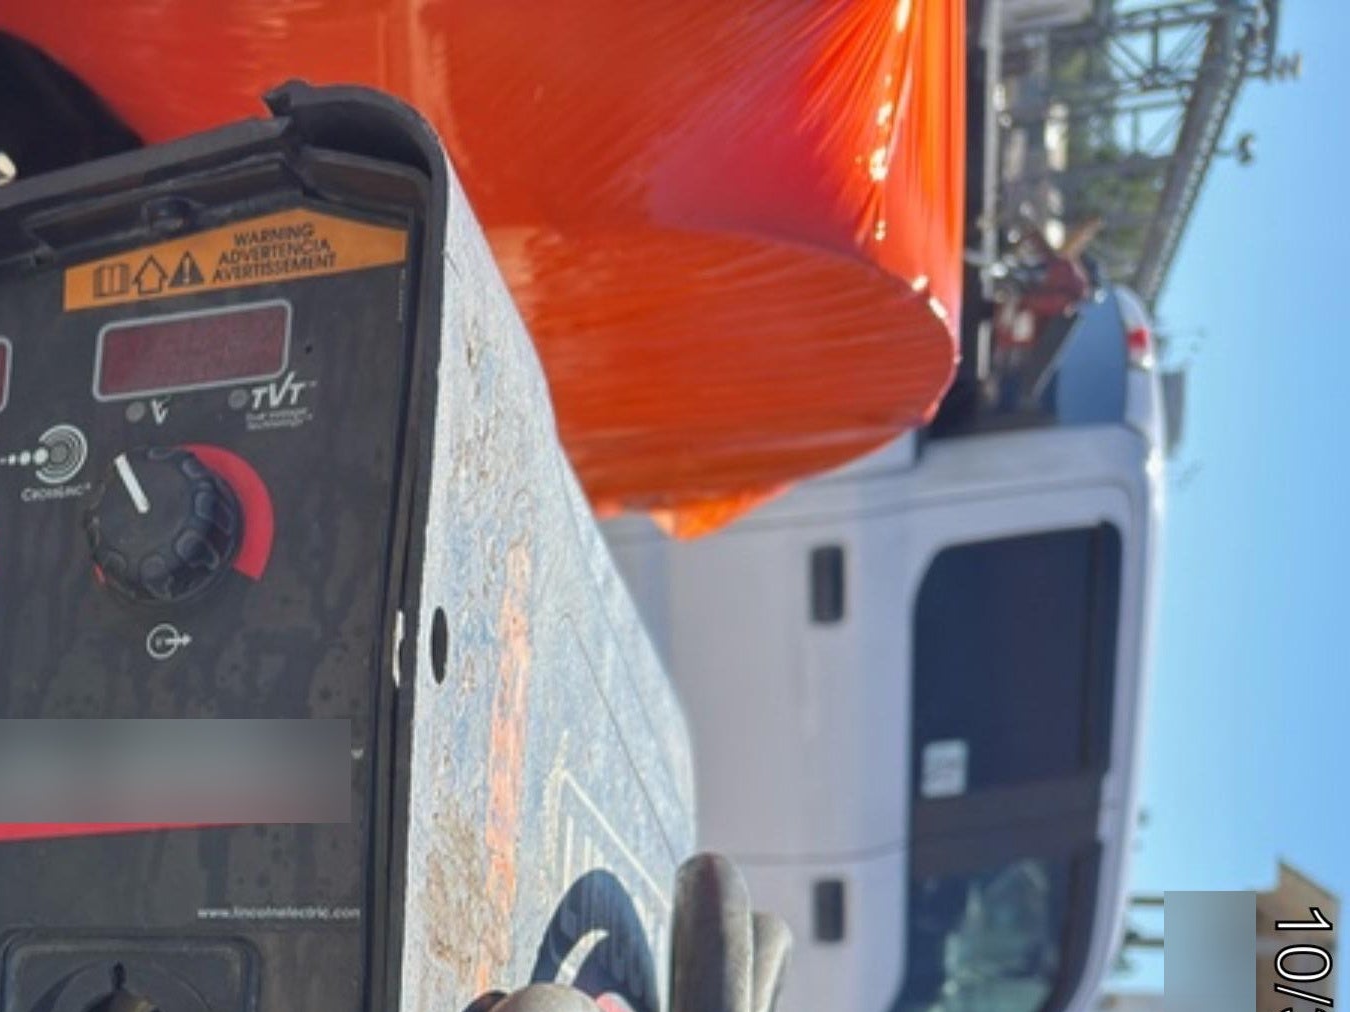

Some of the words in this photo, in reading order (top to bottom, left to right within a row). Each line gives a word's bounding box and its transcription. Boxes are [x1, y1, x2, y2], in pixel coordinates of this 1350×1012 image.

[233, 222, 314, 247] WARNING
[218, 238, 331, 266] ADVERTENCIA
[212, 251, 336, 283] AVERTISSEMENT
